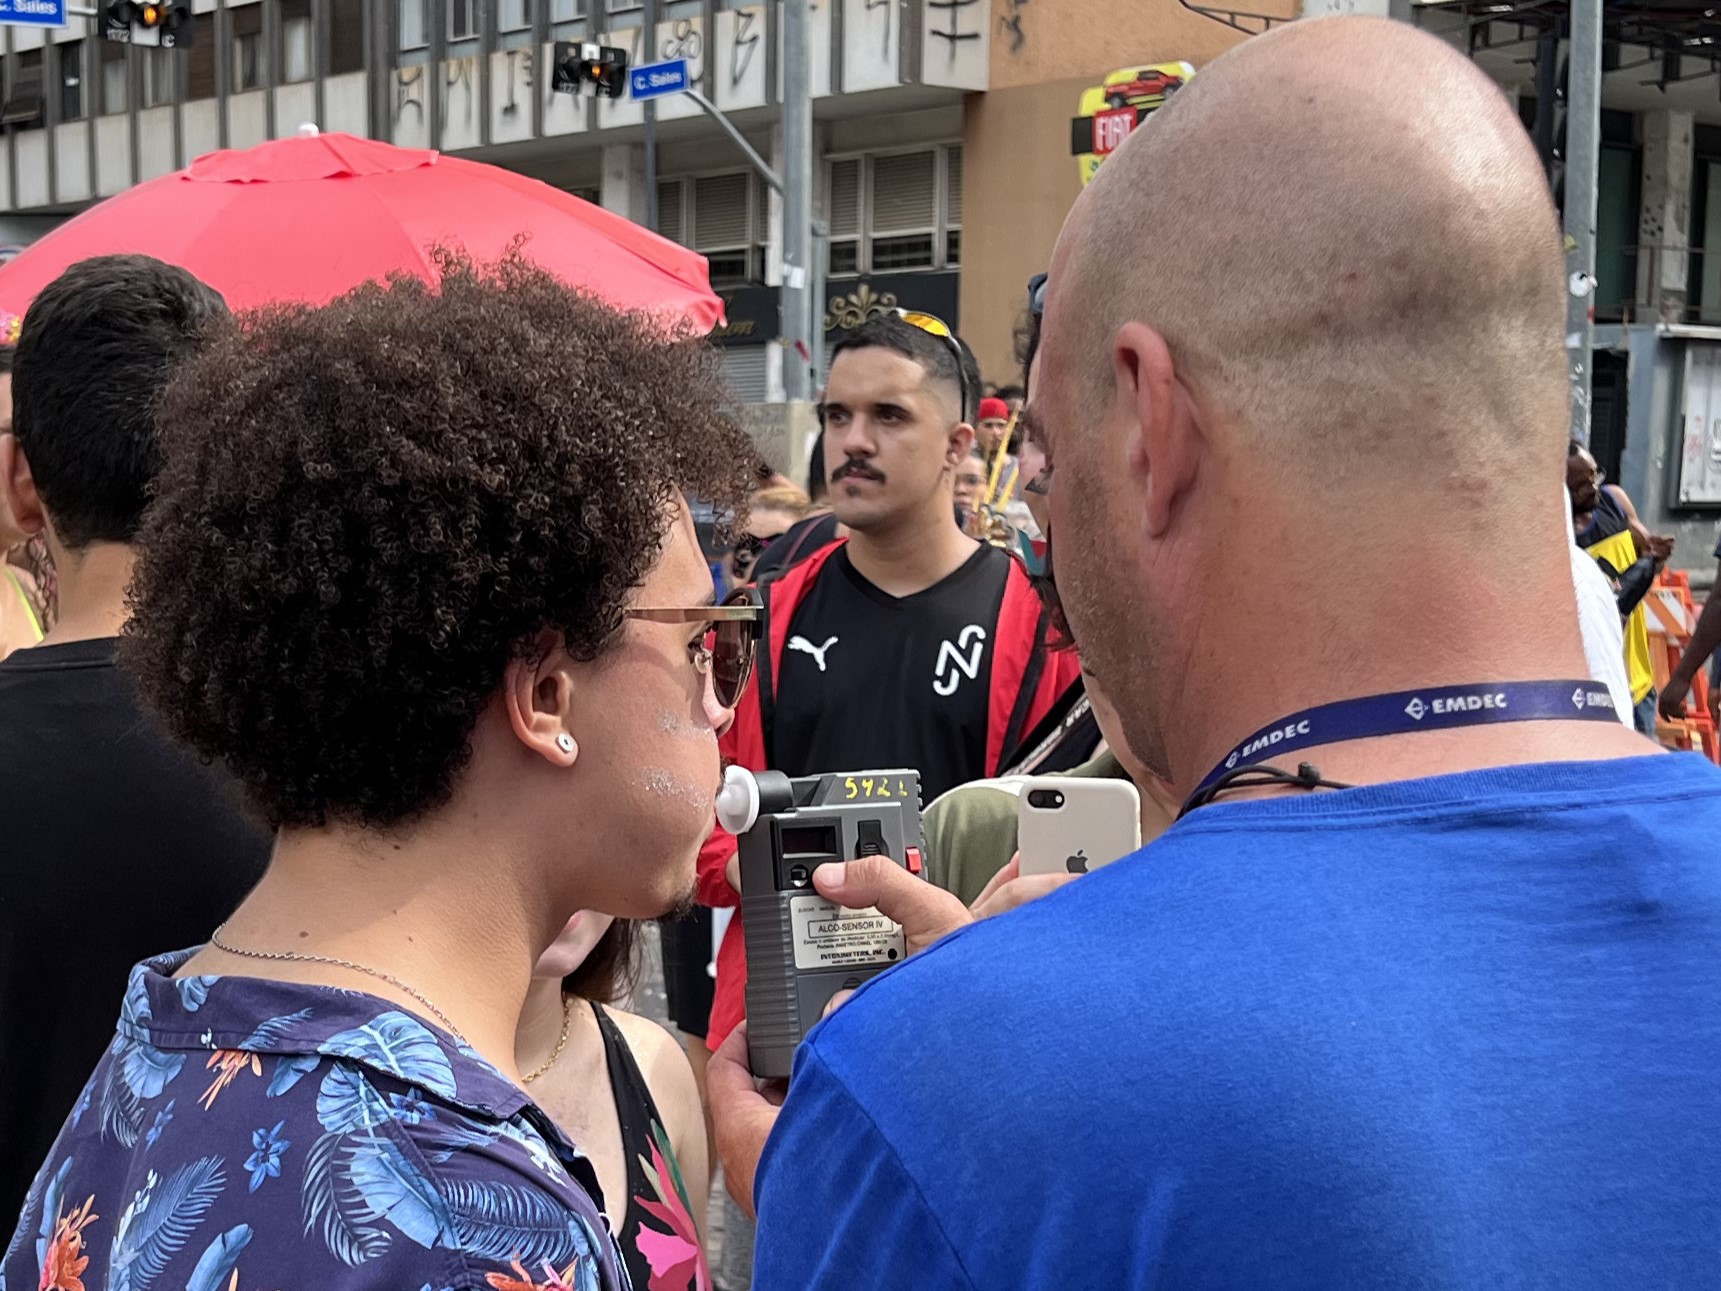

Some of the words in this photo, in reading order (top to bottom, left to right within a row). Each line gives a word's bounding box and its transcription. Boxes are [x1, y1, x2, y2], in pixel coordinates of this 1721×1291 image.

[14, 0, 57, 15] Sales
[633, 75, 649, 90] C.
[649, 72, 683, 88] Sales
[1095, 113, 1133, 152] FIAT
[1432, 693, 1508, 714] EMDEC
[1242, 720, 1310, 757] EMDEC
[818, 922, 874, 933] ALCO-SENSOR
